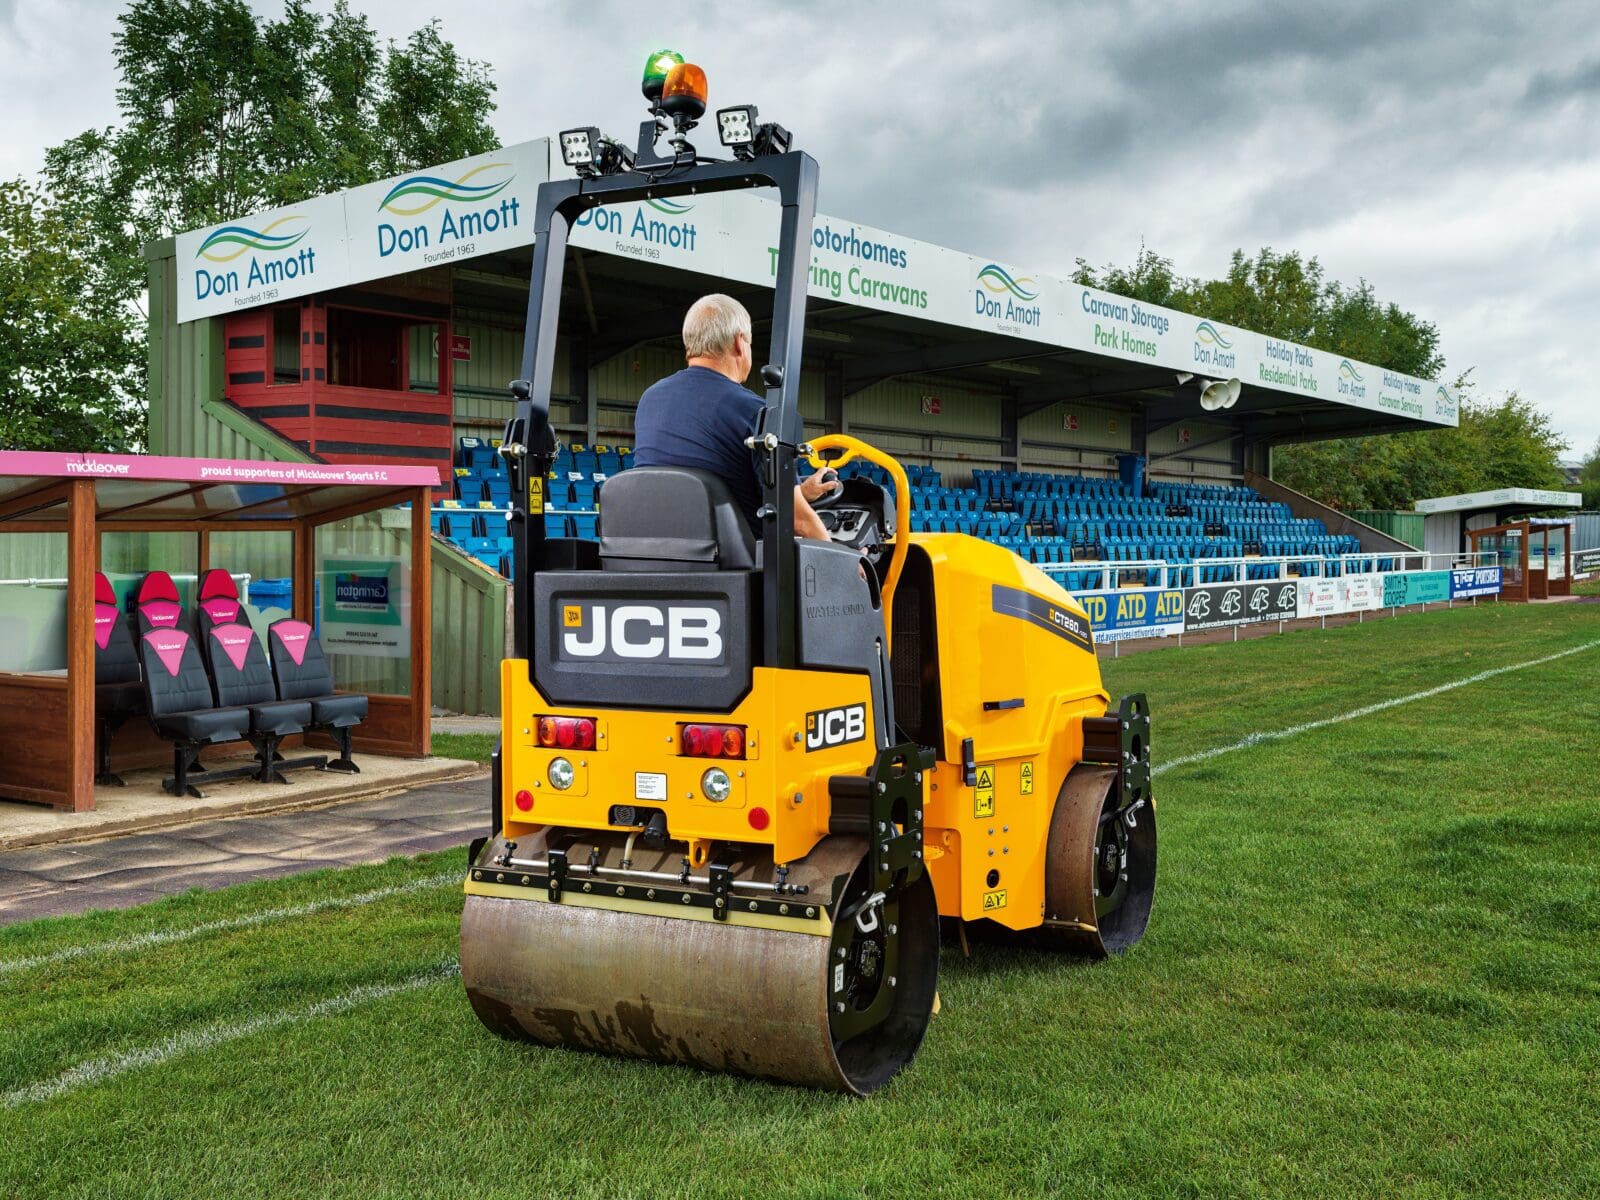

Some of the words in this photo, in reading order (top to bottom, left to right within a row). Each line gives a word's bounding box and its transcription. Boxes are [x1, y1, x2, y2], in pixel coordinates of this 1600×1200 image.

[378, 223, 429, 257] Don
[438, 196, 520, 243] Amott
[576, 207, 622, 235] Don
[630, 206, 697, 251] Amott
[424, 249, 455, 264] Founded
[456, 243, 475, 257] 1963
[615, 241, 643, 256] Founded
[644, 247, 660, 259] 1963
[810, 225, 907, 268] otorhomes
[195, 268, 239, 300] Don
[247, 247, 315, 288] Amott
[768, 247, 842, 297] Tring
[847, 267, 928, 309] Caravans
[234, 291, 261, 306] Founded
[262, 288, 279, 300] 1963
[975, 289, 1001, 318] Don
[1005, 297, 1041, 327] Amott
[1081, 290, 1129, 322] Caravan
[1130, 303, 1169, 335] Storage
[1094, 323, 1119, 349] Park
[1121, 330, 1157, 357] Homes
[1266, 340, 1293, 366] Holiday
[1295, 348, 1313, 367] Parks
[1194, 342, 1210, 364] Don
[1213, 347, 1235, 368] Amott
[1259, 363, 1298, 386] Residential
[1299, 373, 1317, 391] Parks
[1383, 371, 1403, 393] Holiday
[66, 459, 130, 474] mickleover
[201, 465, 232, 477] proud
[234, 467, 284, 480] supporters
[285, 468, 295, 479] of
[296, 469, 345, 481] Mickleover
[345, 470, 374, 482] Sports
[806, 605, 840, 619] WATER
[843, 603, 865, 616] ONLY
[1116, 593, 1147, 620] ATD
[1155, 591, 1183, 617] ATD
[563, 605, 723, 660] JCB
[807, 706, 865, 748] JCB
